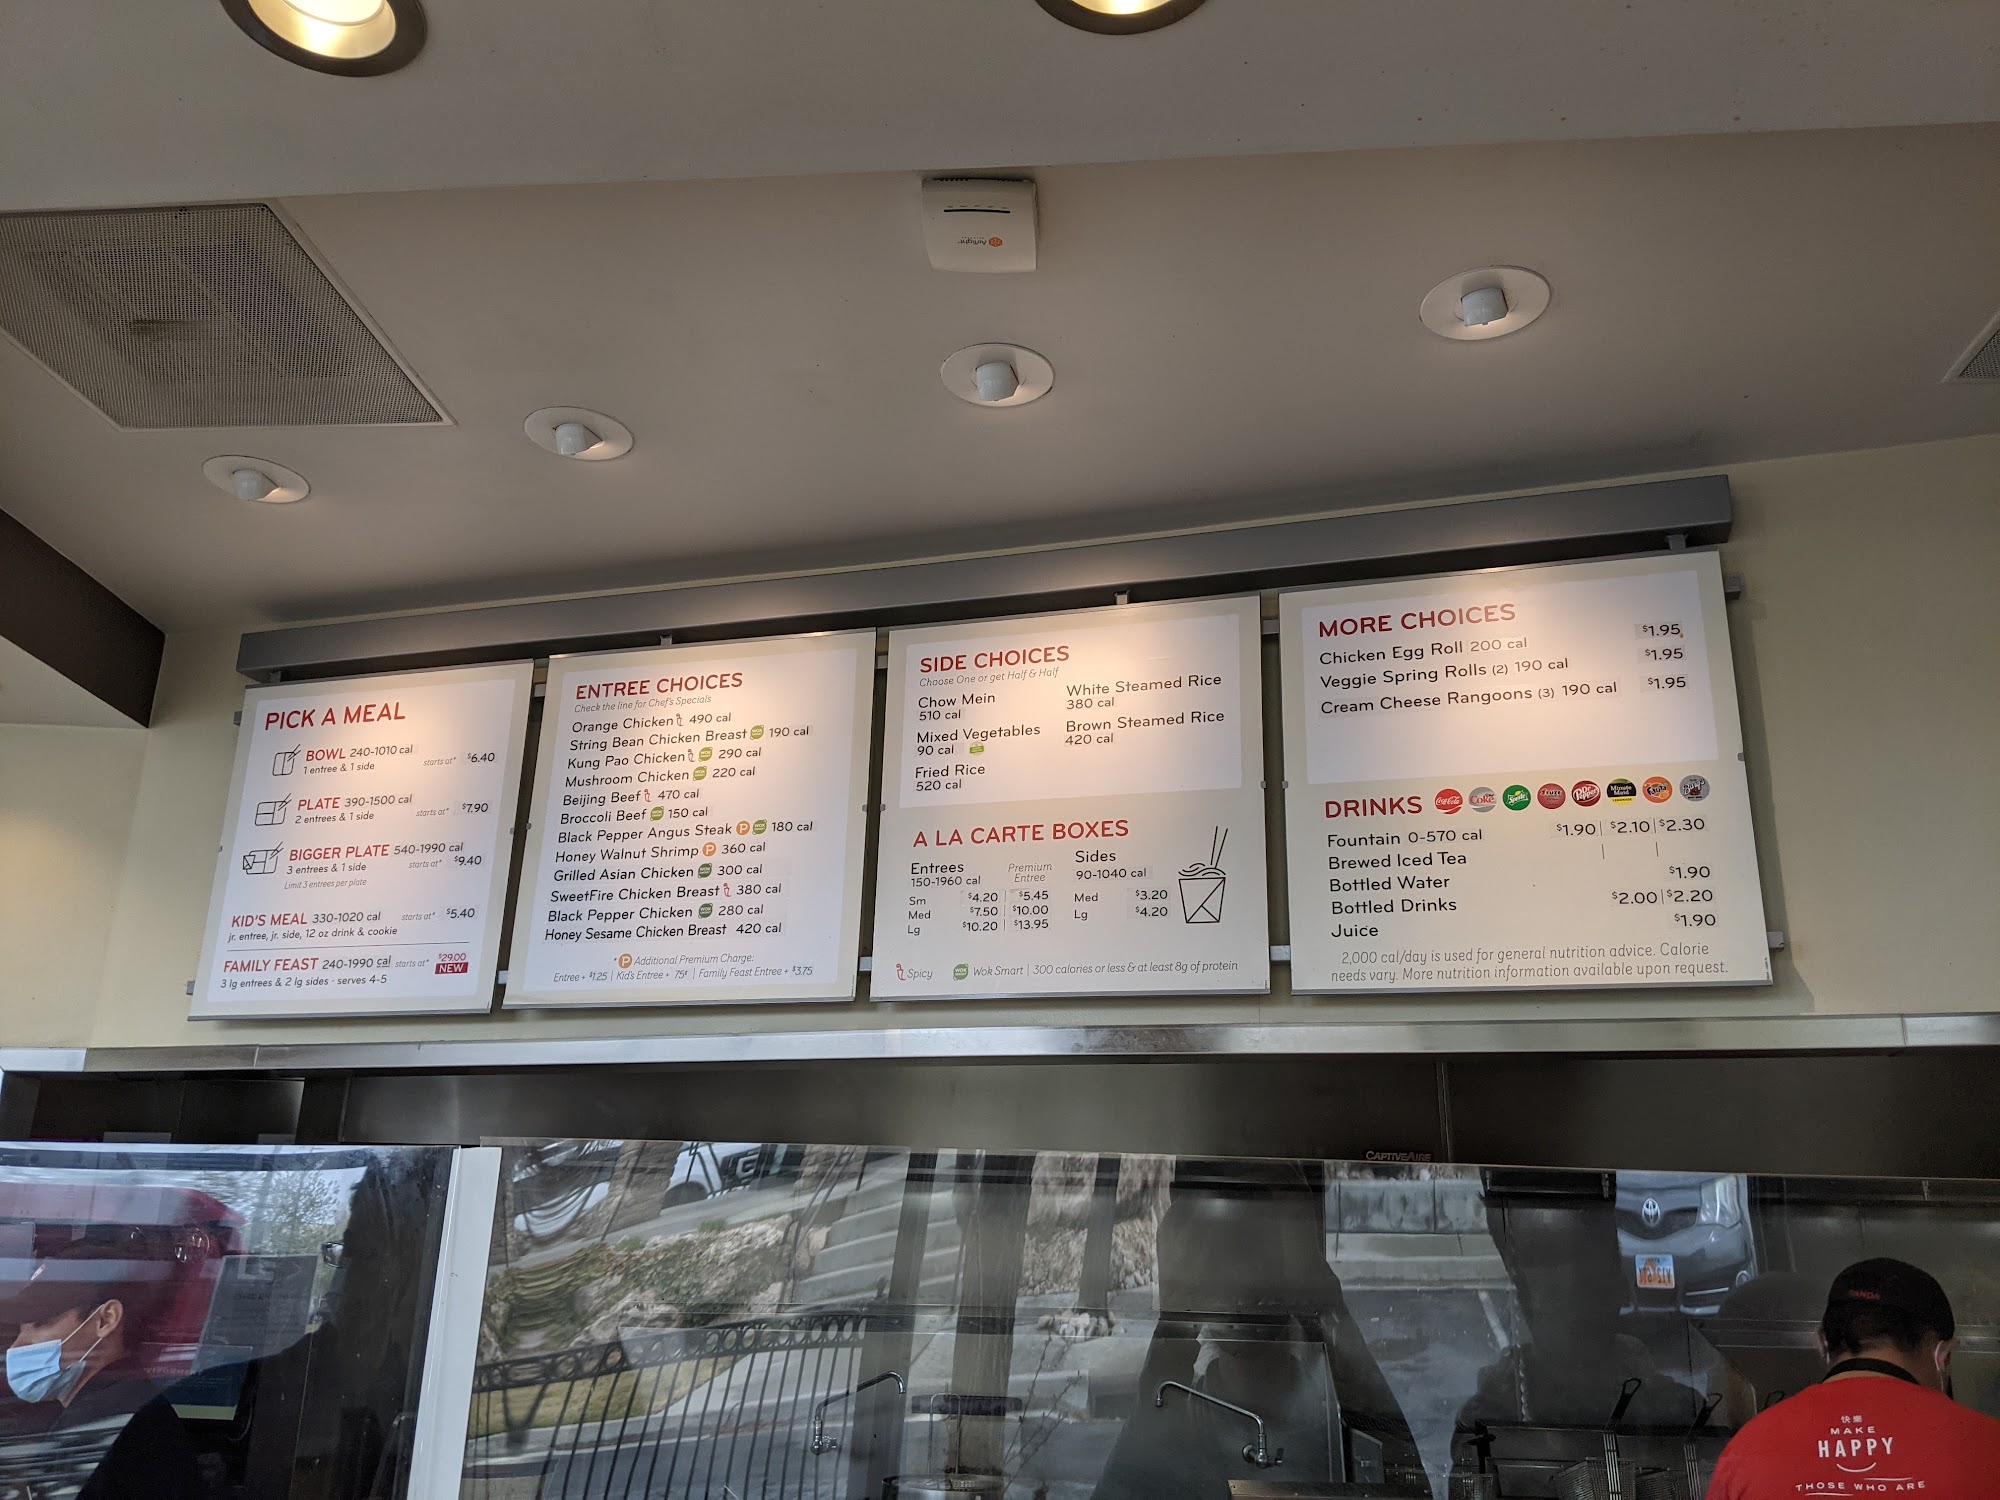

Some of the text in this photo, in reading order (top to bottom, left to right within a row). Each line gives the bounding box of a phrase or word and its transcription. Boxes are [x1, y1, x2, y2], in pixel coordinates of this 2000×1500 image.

[1320, 604, 1515, 637] MORE CHOICES
[1643, 624, 1680, 636] $1.95
[1320, 637, 1527, 664] Chicken Egg Roll 200 cal
[920, 646, 1069, 673] SIDE CHOICES
[920, 678, 954, 687] Choose
[956, 675, 976, 684] One
[990, 673, 1005, 683] get
[1007, 668, 1028, 681] Half
[1029, 669, 1037, 678] &
[1039, 667, 1059, 678] Half
[576, 673, 742, 701] ENTREE CHOICES
[1067, 675, 1221, 696] White Steamed Rice
[575, 695, 712, 713] Check the line for Chef's Specials
[918, 693, 995, 708] Chow Mein
[265, 702, 405, 730] PICK A MEAL
[572, 712, 731, 733] Orange Chicken 490 cal
[306, 744, 413, 761] BOWL 240-1010 cal
[468, 752, 495, 763] $6.40
[298, 794, 412, 811] PLATE 390-1500 cal
[462, 803, 488, 813] $7.90
[1325, 796, 1422, 818] DRINKS
[558, 821, 813, 843] Black Pepper Angus Steak 180 cal
[913, 820, 1128, 847] A LA CARTE BOXES
[1557, 818, 1705, 836] $1.90 $2.10 $2.30
[1328, 829, 1482, 847] Fountain 0-570 cal
[289, 842, 463, 861] BIGGER PLATE 540-1990 cal
[1075, 850, 1116, 863] Sides
[454, 856, 482, 866] $9.40
[911, 863, 964, 874] Entrees
[1008, 862, 1052, 872] Premium
[1014, 873, 1046, 883] Entree
[1076, 868, 1146, 880] 90-1040 cal
[284, 881, 302, 889] Limit
[348, 878, 367, 888] plate
[909, 896, 926, 905] Sm
[968, 890, 1048, 902] $4.20 $5.45
[232, 911, 381, 927] KID'S MEAL 330-1020 cal
[446, 908, 475, 919] $5.40
[1674, 913, 1716, 926] $1.90
[908, 925, 920, 936] Lg
[963, 919, 1048, 931] $10.20 $13.95
[1331, 924, 1378, 937] Juice
[439, 953, 466, 961] $29.00
[634, 953, 754, 965] Additional Premium Charge:
[1342, 942, 1709, 966] 2,000 cal/day is used for general nutrition advice. Calorie
[224, 955, 391, 972] FAMILY FEAST 240-1990 cal
[439, 963, 464, 974] NEW
[974, 966, 993, 976] Wok
[994, 966, 1024, 976] Smart
[1033, 964, 1053, 974] 300
[1055, 964, 1093, 974] calories
[1095, 965, 1106, 973] or
[1107, 963, 1126, 973] less
[1127, 962, 1136, 972] &
[1137, 963, 1148, 972] at
[1150, 962, 1173, 972] least
[1175, 961, 1188, 974] 8g
[1190, 961, 1201, 973] of
[1202, 961, 1238, 973] protein
[907, 968, 933, 981] Spicy
[1332, 960, 1728, 984] needs vary. More nutrition information available upon request.
[1830, 1426, 1875, 1435] MAKE
[1818, 1437, 1893, 1458] HAPPY
[1795, 1480, 1925, 1491] THOSE WHO ARE
